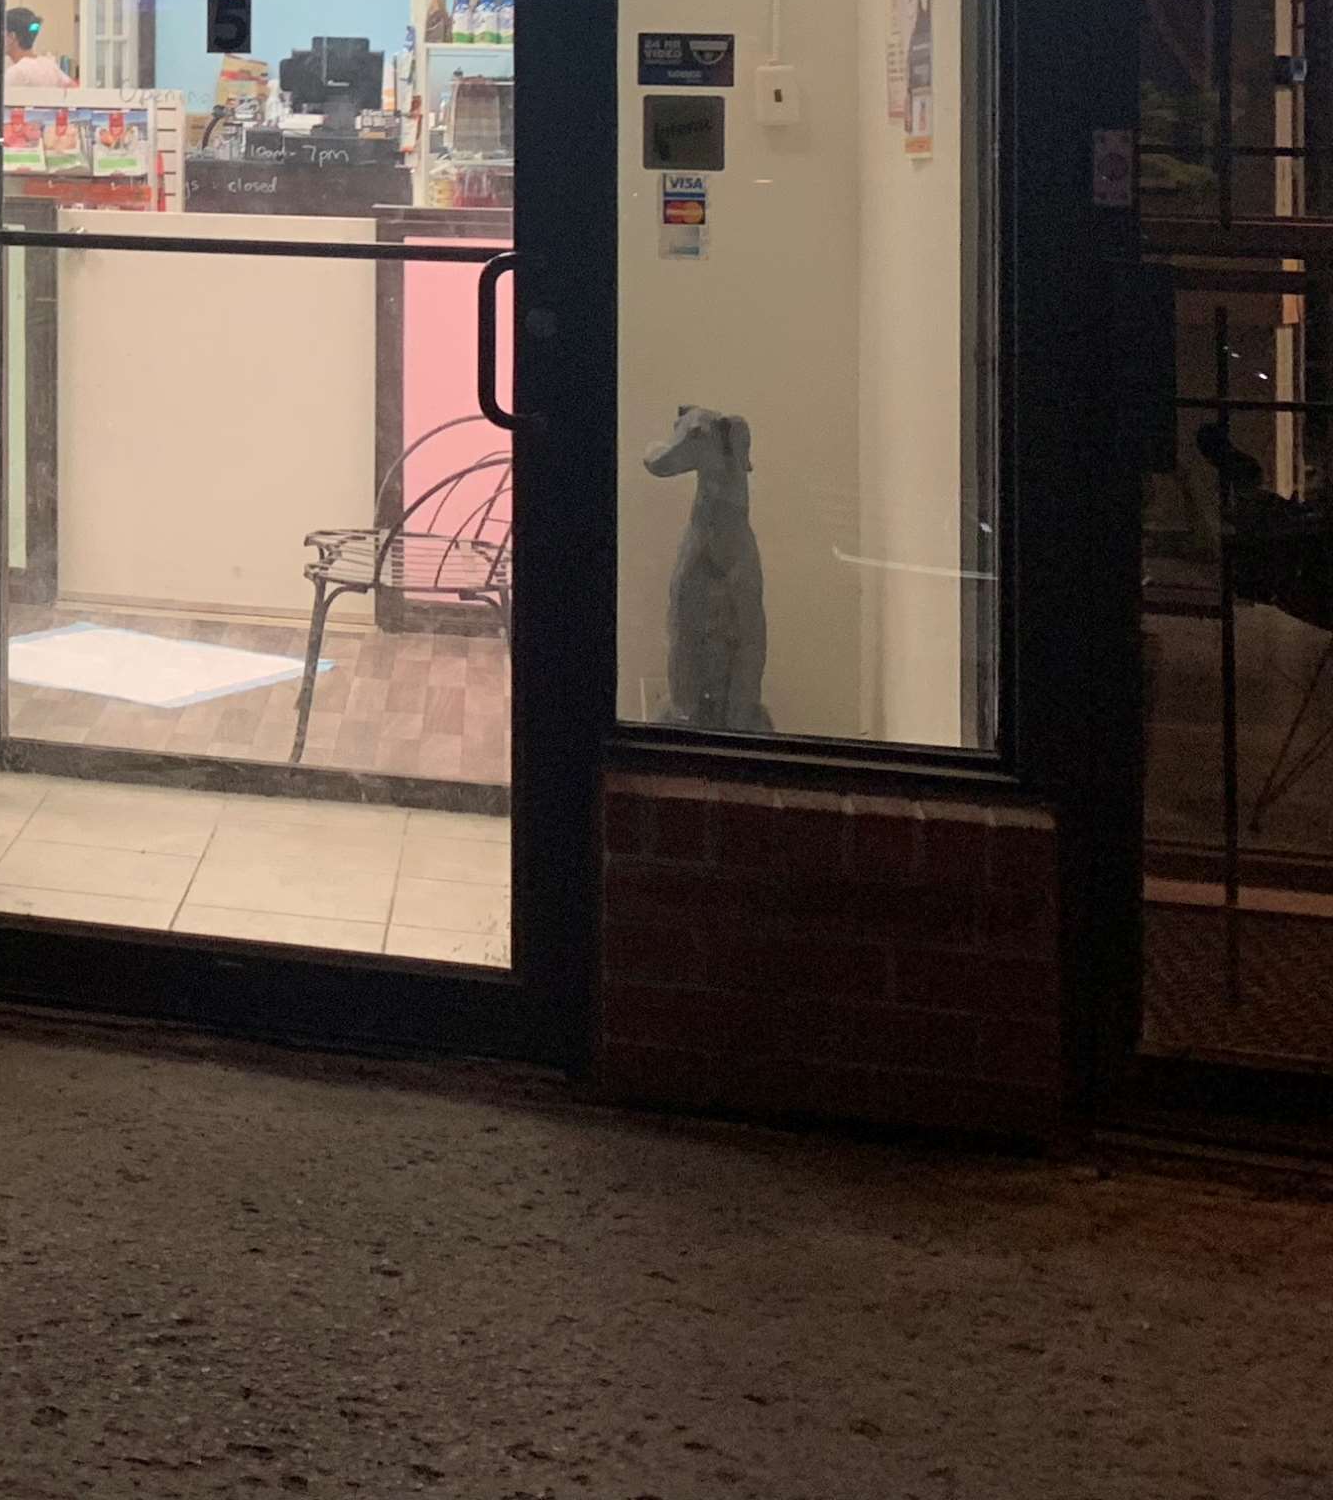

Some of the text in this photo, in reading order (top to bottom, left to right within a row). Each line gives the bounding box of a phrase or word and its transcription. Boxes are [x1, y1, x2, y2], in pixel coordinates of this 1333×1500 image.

[213, 0, 248, 51] 5
[303, 145, 349, 166] 7pm
[228, 176, 278, 194] closed
[669, 177, 703, 189] VISA
